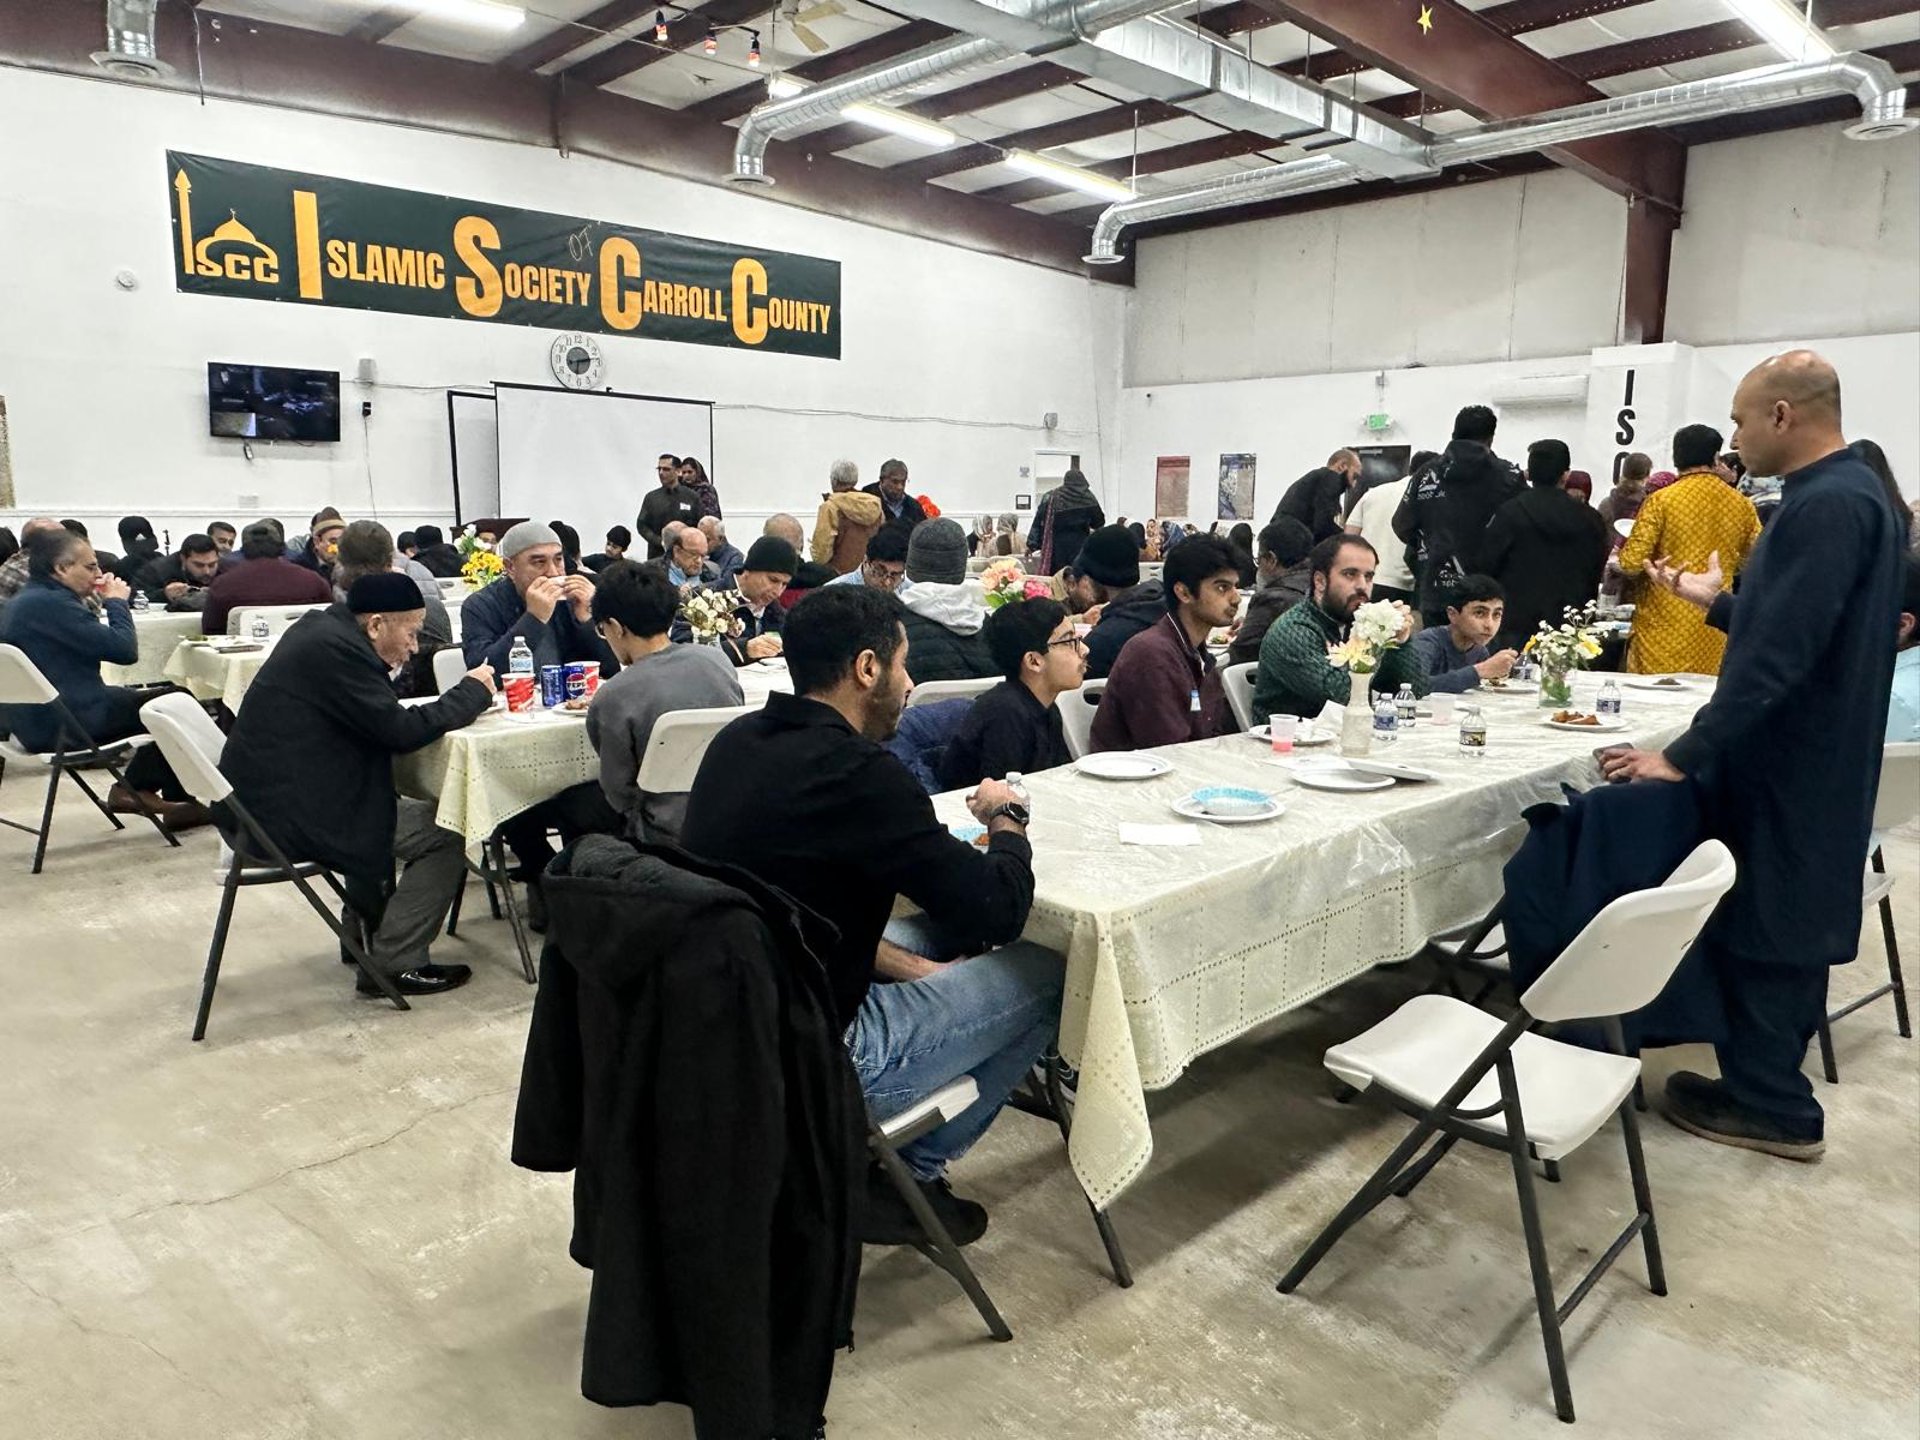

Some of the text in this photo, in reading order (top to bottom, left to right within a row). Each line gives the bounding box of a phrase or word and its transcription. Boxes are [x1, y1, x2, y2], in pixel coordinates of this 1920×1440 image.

[293, 190, 831, 345] ISLAMIC SOCIETY CARROLL COUNTY
[574, 335, 583, 344] 12
